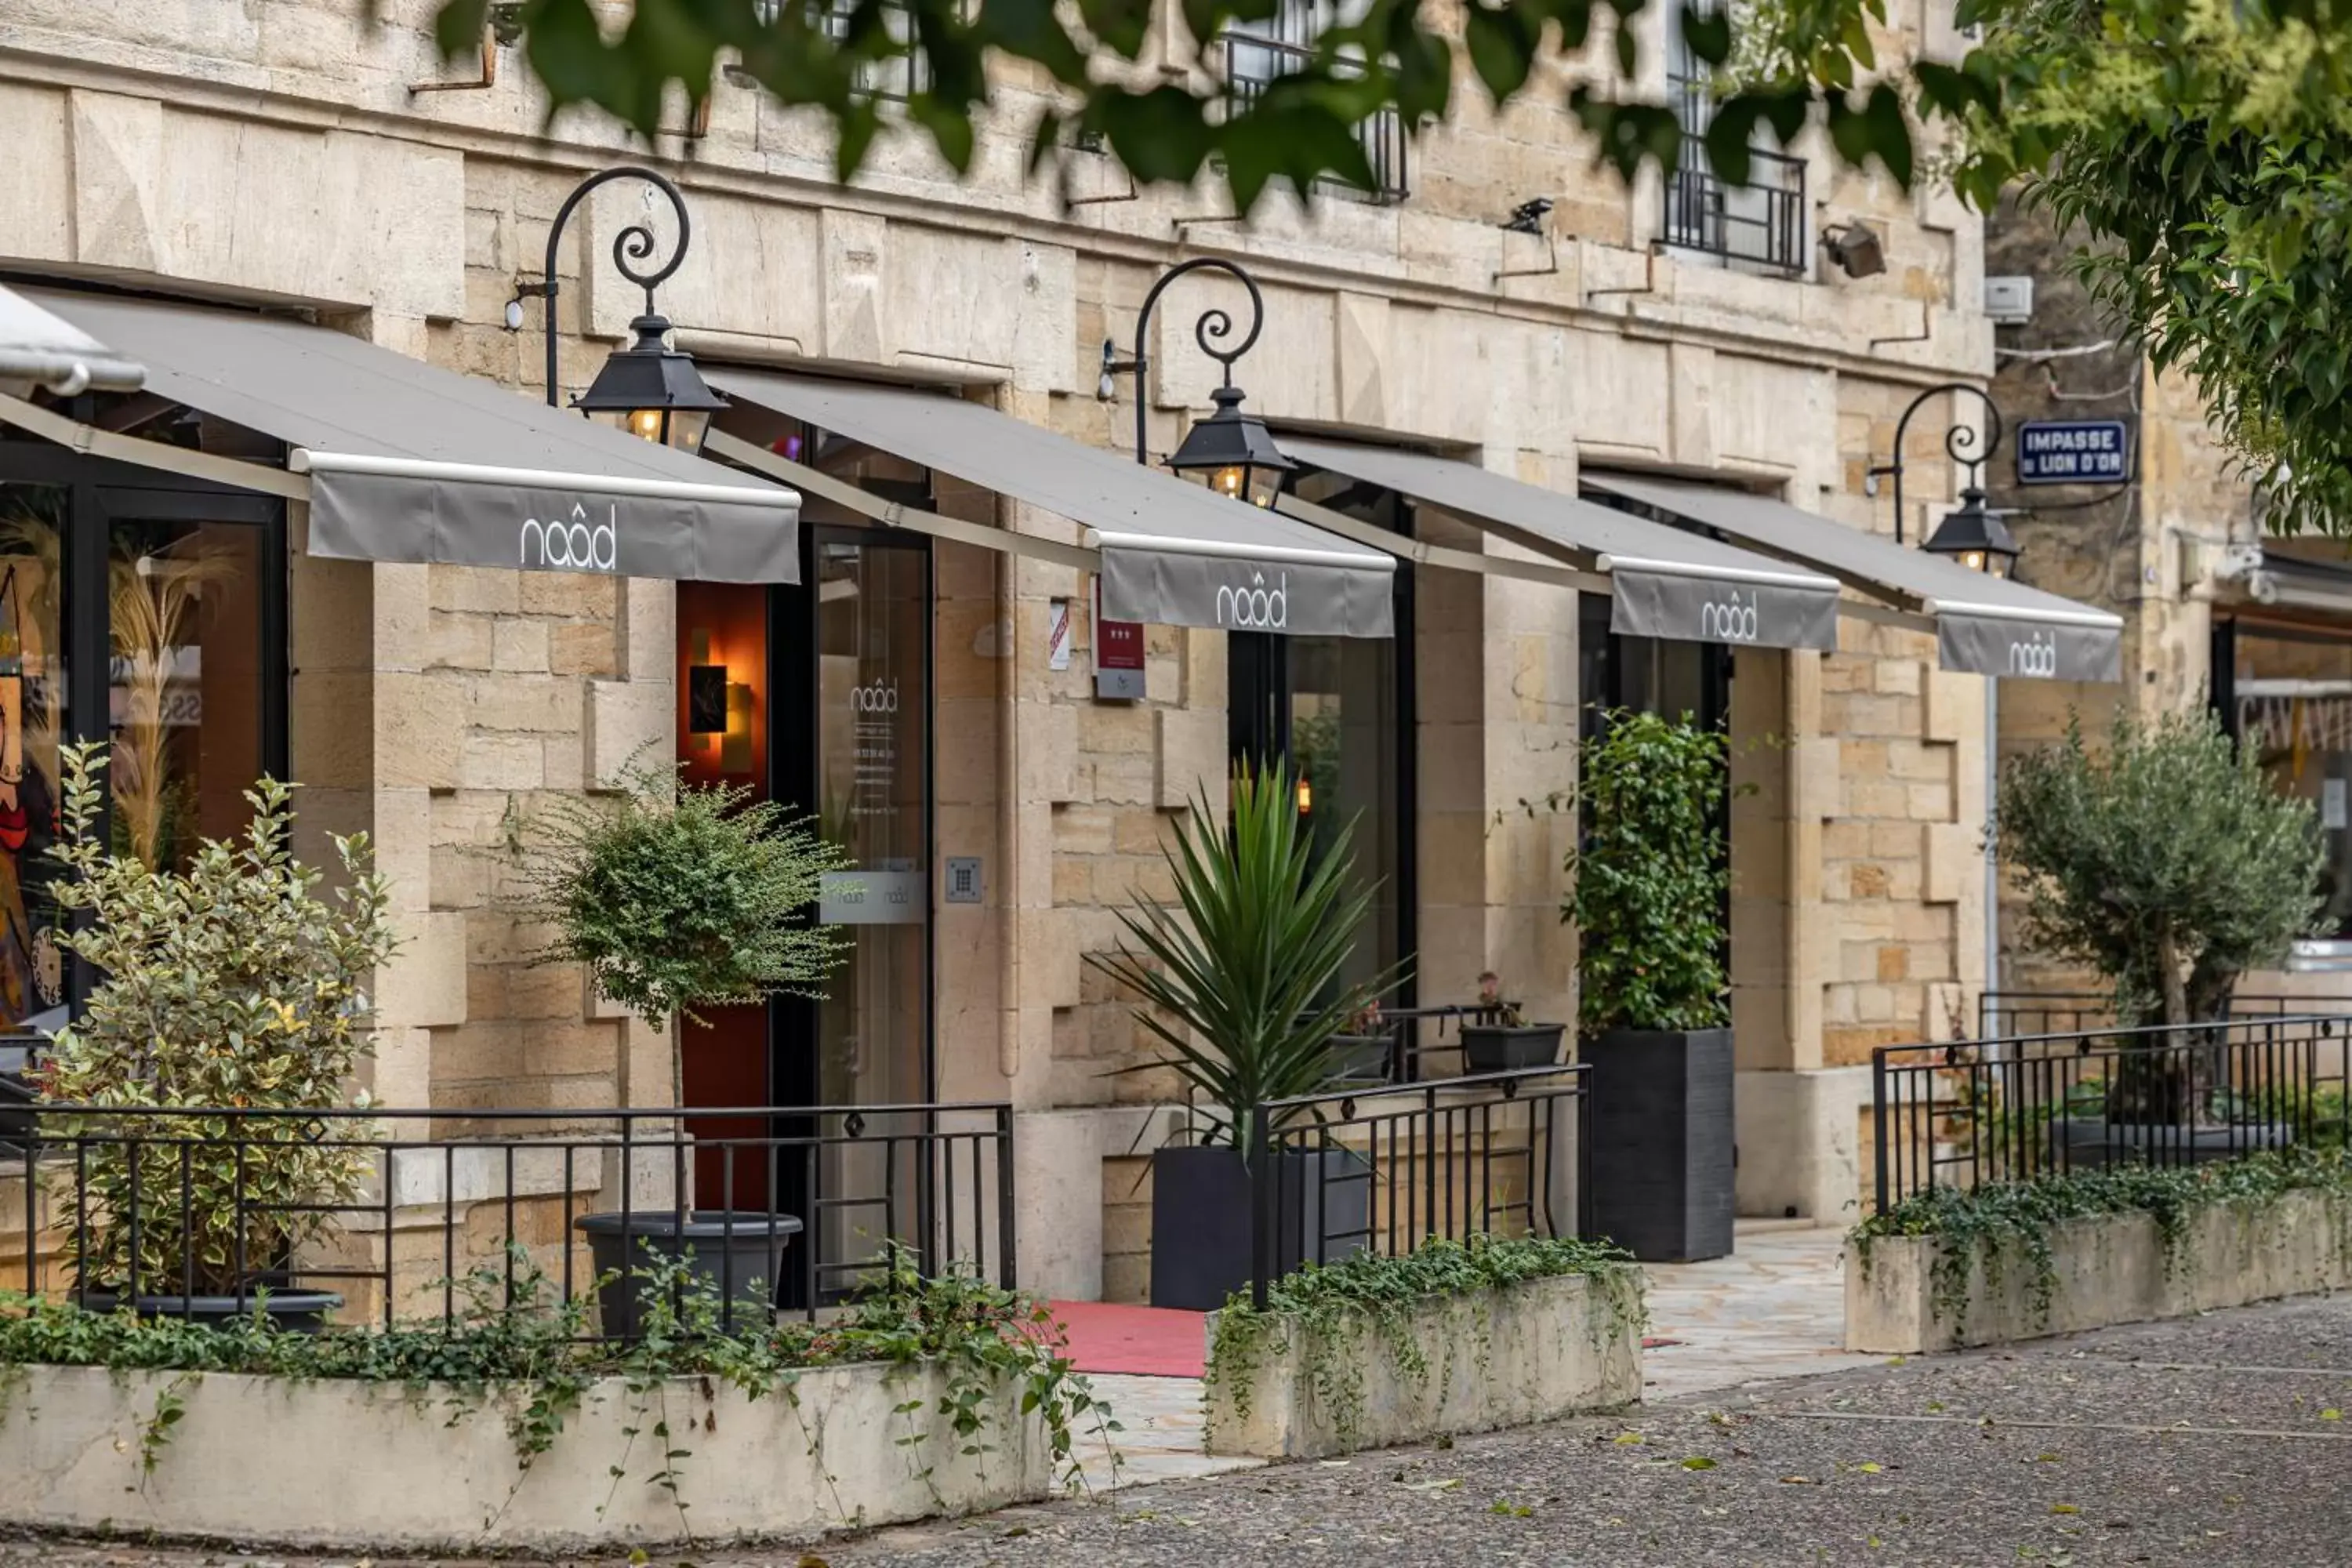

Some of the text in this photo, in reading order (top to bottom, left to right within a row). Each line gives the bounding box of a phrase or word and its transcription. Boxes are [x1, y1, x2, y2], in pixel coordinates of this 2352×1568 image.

[2026, 430, 2114, 451] IMPASSE
[2039, 453, 2077, 473] LION
[2080, 452, 2120, 473] D'OR
[521, 502, 616, 570] naâd
[1216, 571, 1286, 628] naâd
[1701, 590, 1757, 641] naâd
[851, 677, 898, 713] naâd
[2238, 695, 2352, 753] CAVAVI
